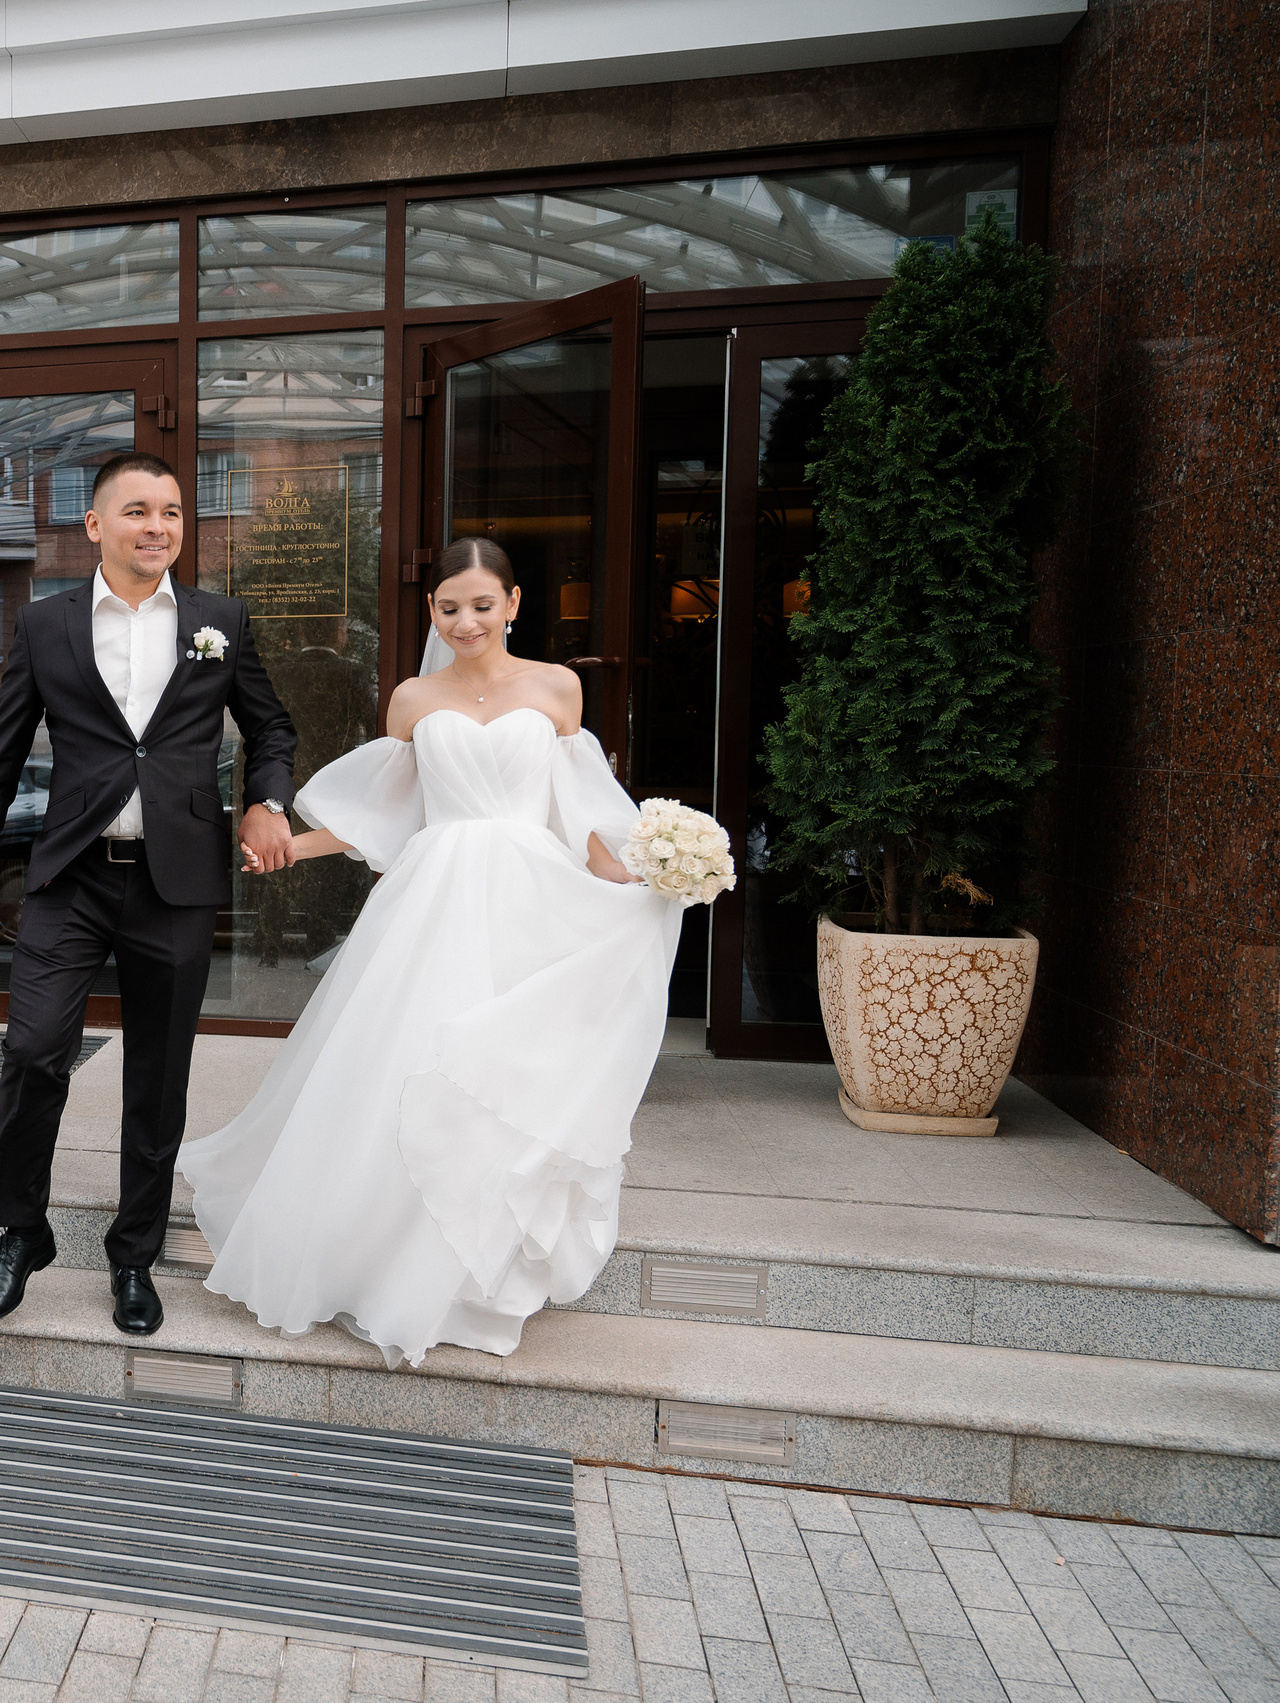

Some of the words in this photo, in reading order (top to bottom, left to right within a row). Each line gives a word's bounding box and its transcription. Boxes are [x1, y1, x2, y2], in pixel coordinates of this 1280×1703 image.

[265, 497, 310, 508] ВОЛГА
[253, 524, 282, 532] ВРЕМЯ
[284, 522, 324, 531] РАБОТЫ:
[282, 542, 340, 551] КРУГЛОСУТОЧНО
